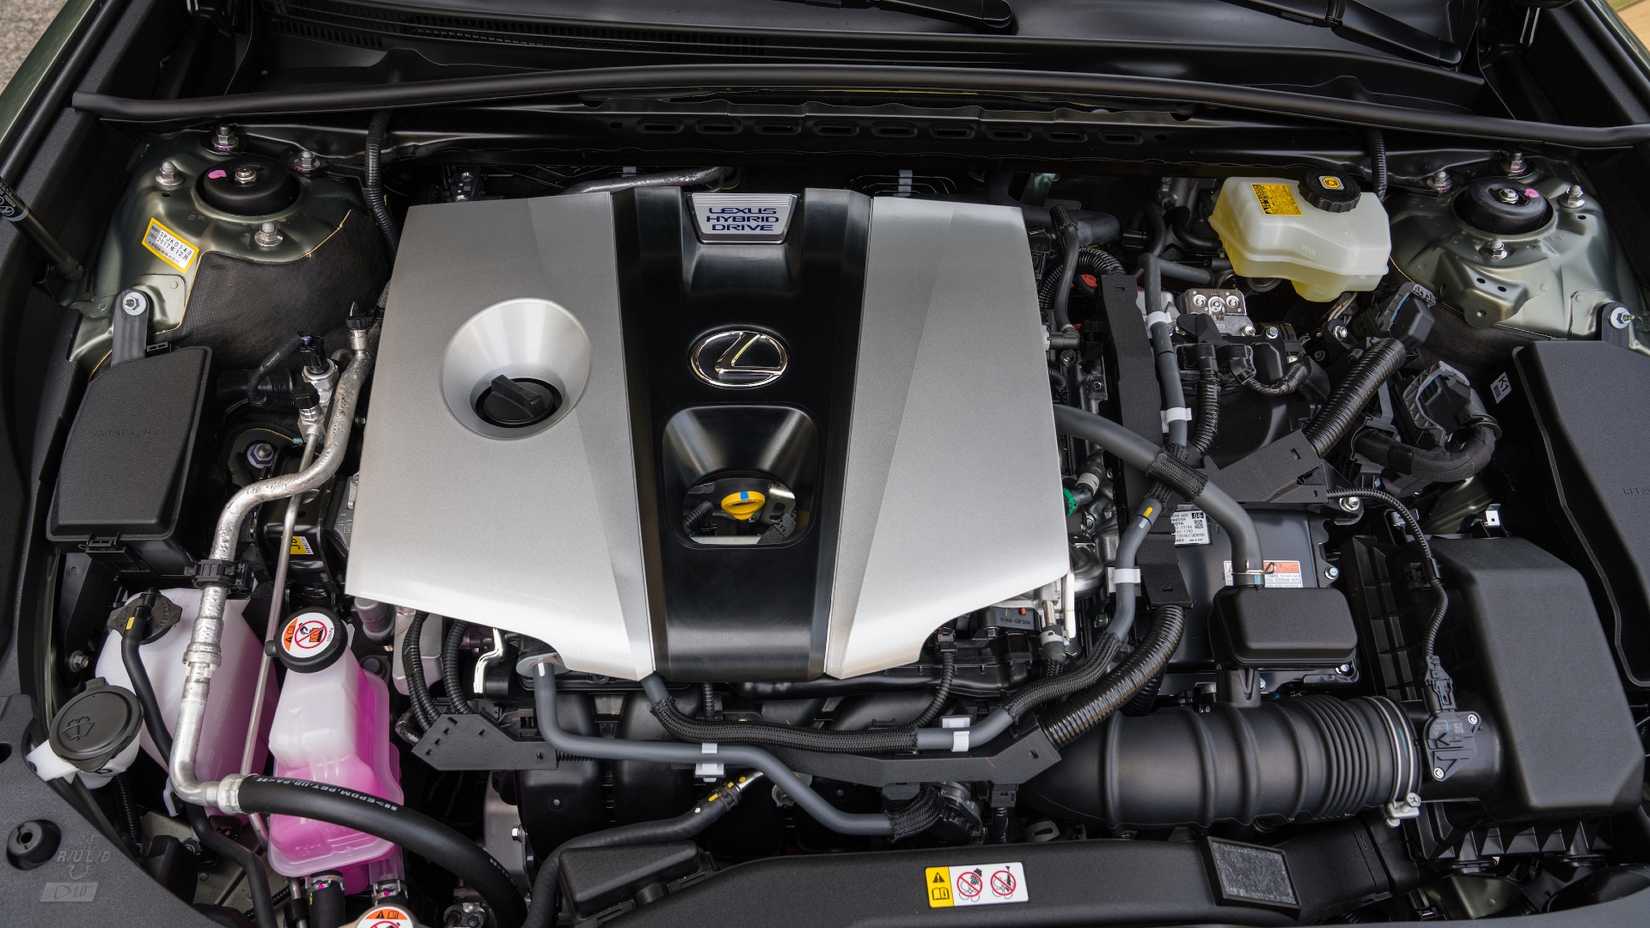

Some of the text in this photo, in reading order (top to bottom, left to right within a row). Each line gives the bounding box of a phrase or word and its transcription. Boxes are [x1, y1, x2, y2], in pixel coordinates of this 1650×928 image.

[708, 207, 777, 215] LEXUS
[705, 215, 780, 223] HYBRID
[711, 223, 774, 231] DRIVE
